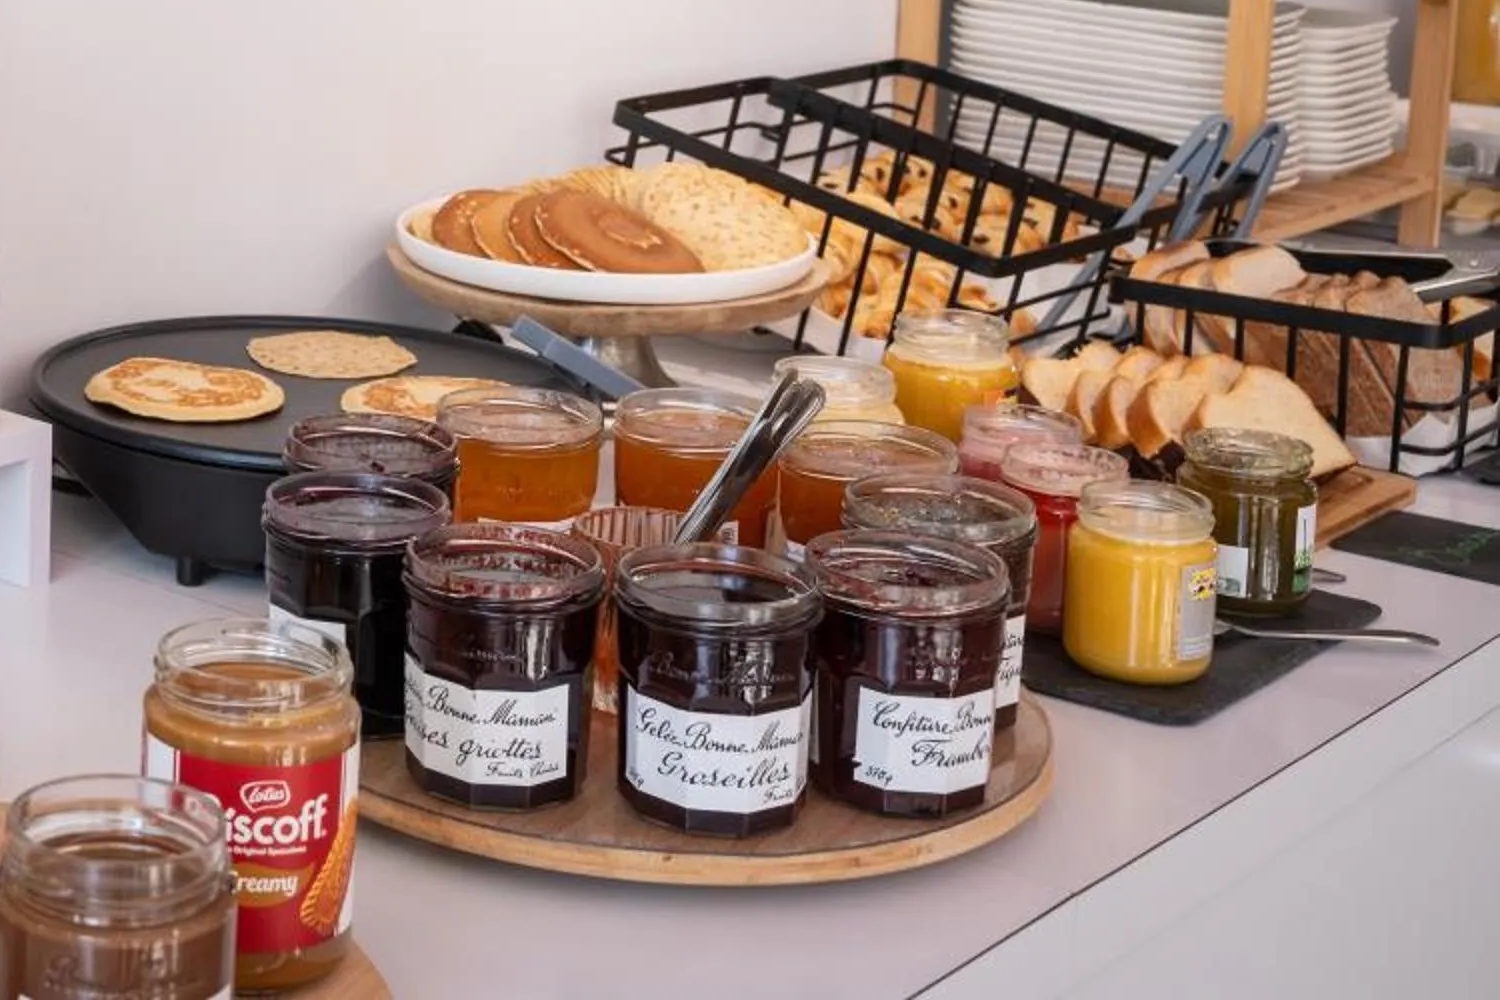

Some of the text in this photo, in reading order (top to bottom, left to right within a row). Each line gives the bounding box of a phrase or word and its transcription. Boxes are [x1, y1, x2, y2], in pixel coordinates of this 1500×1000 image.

[429, 684, 479, 725] Bonne
[484, 699, 556, 728] Maman
[872, 700, 950, 738] Confiture
[455, 737, 544, 767] griottes
[684, 721, 748, 754] Bonne
[657, 750, 792, 790] Groseilles
[249, 786, 286, 804] Lotus
